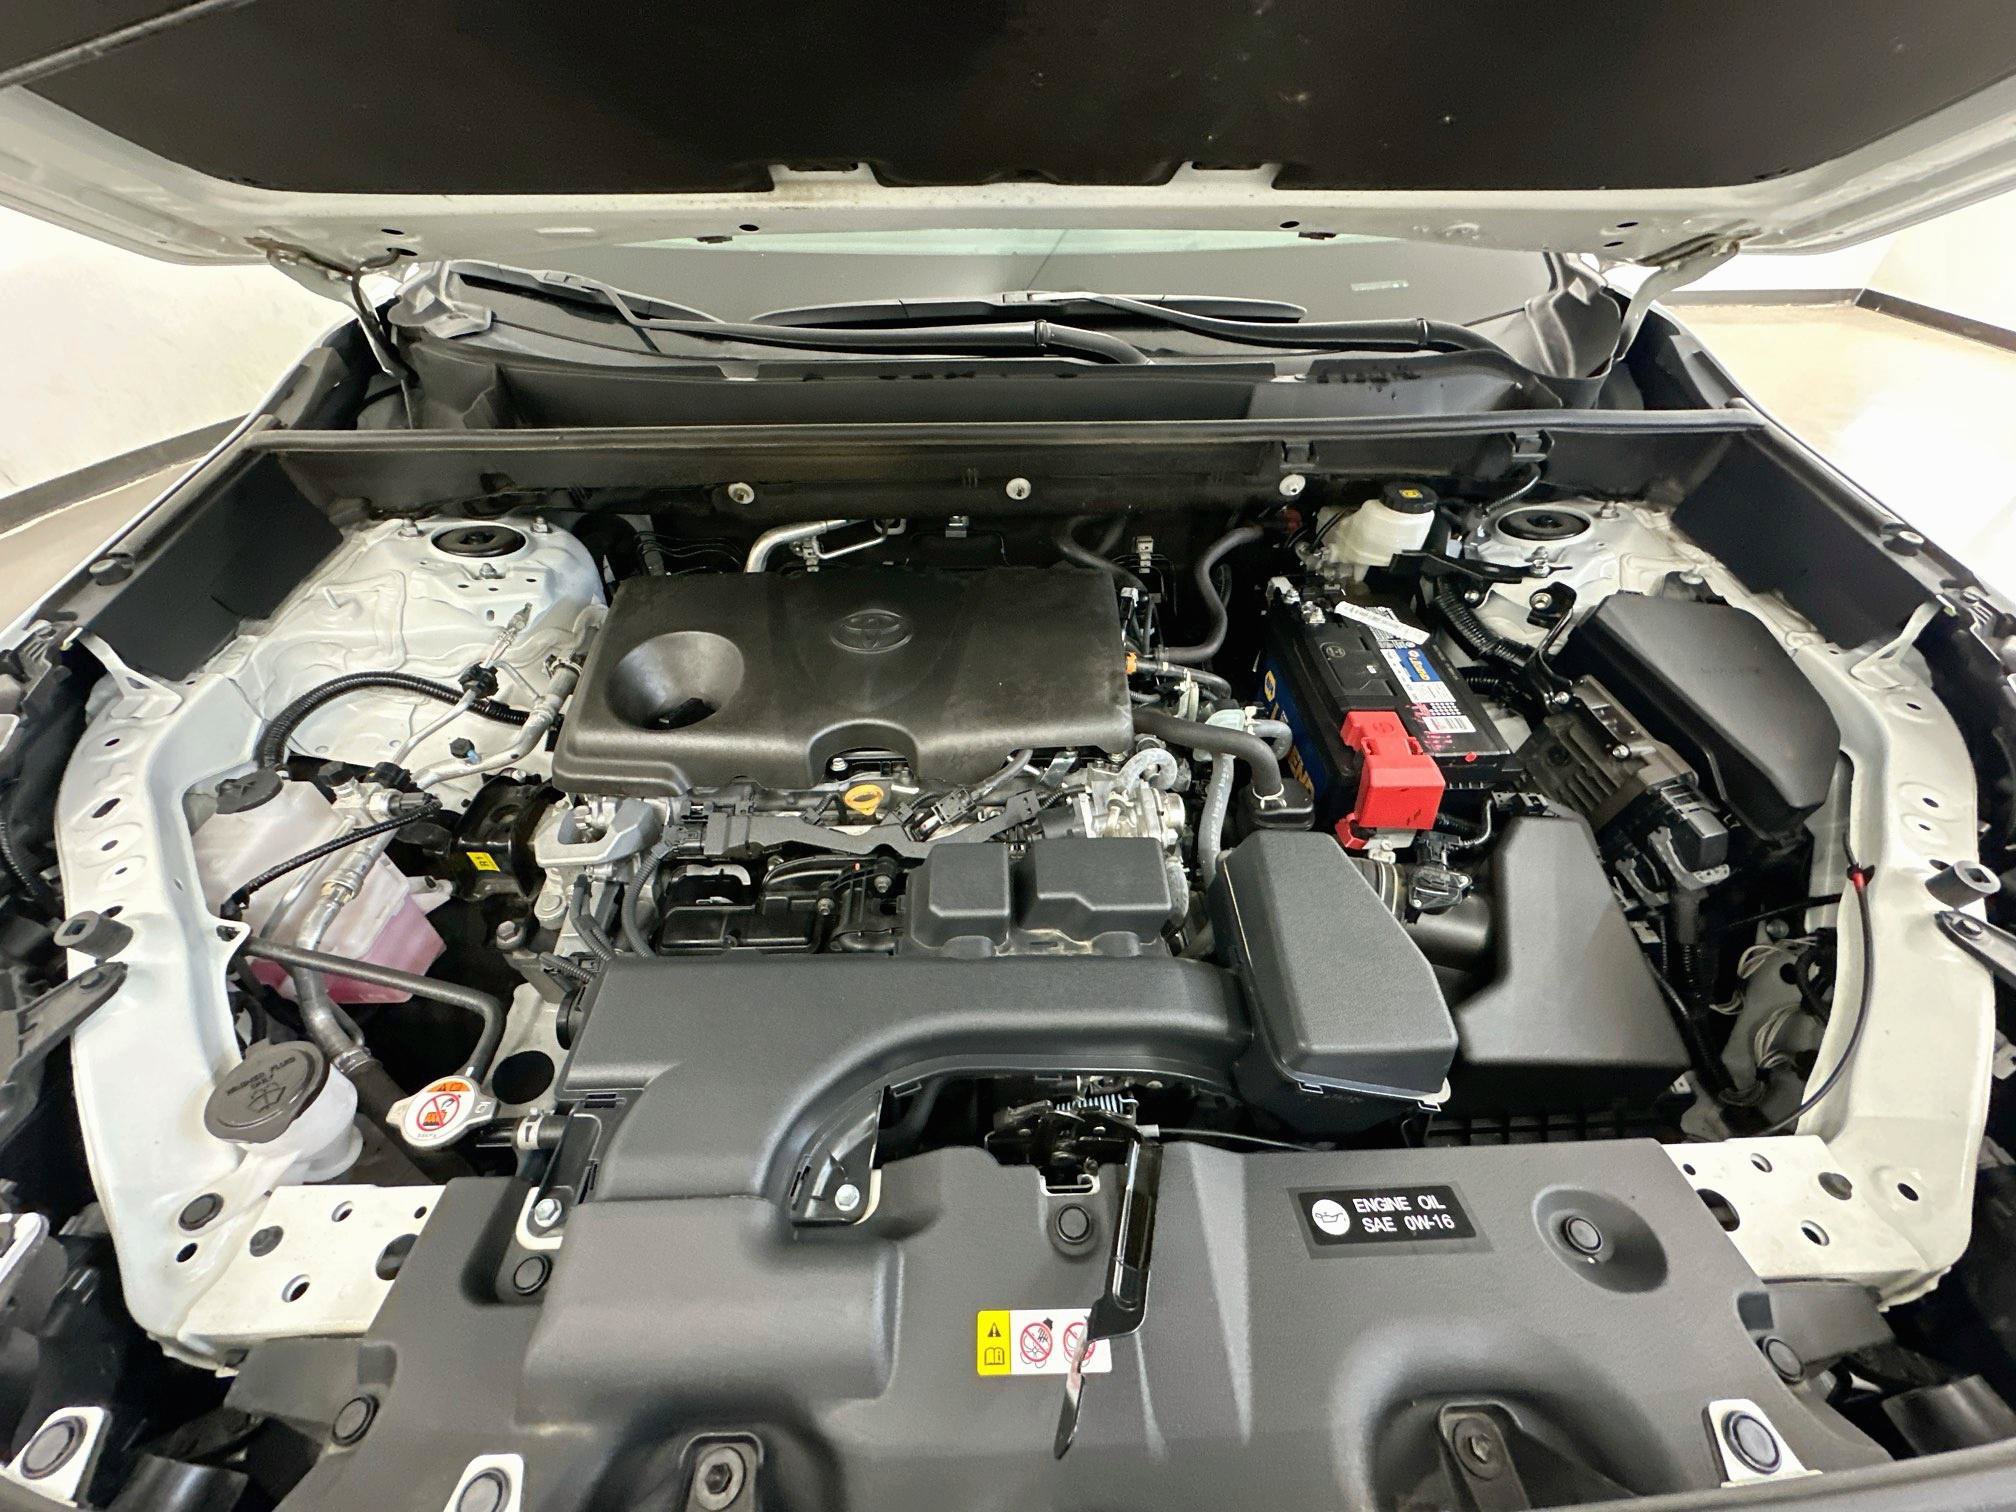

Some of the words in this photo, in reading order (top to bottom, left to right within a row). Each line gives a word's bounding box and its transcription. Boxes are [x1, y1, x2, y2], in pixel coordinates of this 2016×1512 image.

[1352, 1196, 1412, 1213] ENGINE
[1417, 1194, 1447, 1210] OIL
[1361, 1216, 1398, 1233] SAE
[1404, 1214, 1456, 1231] 0W-16
